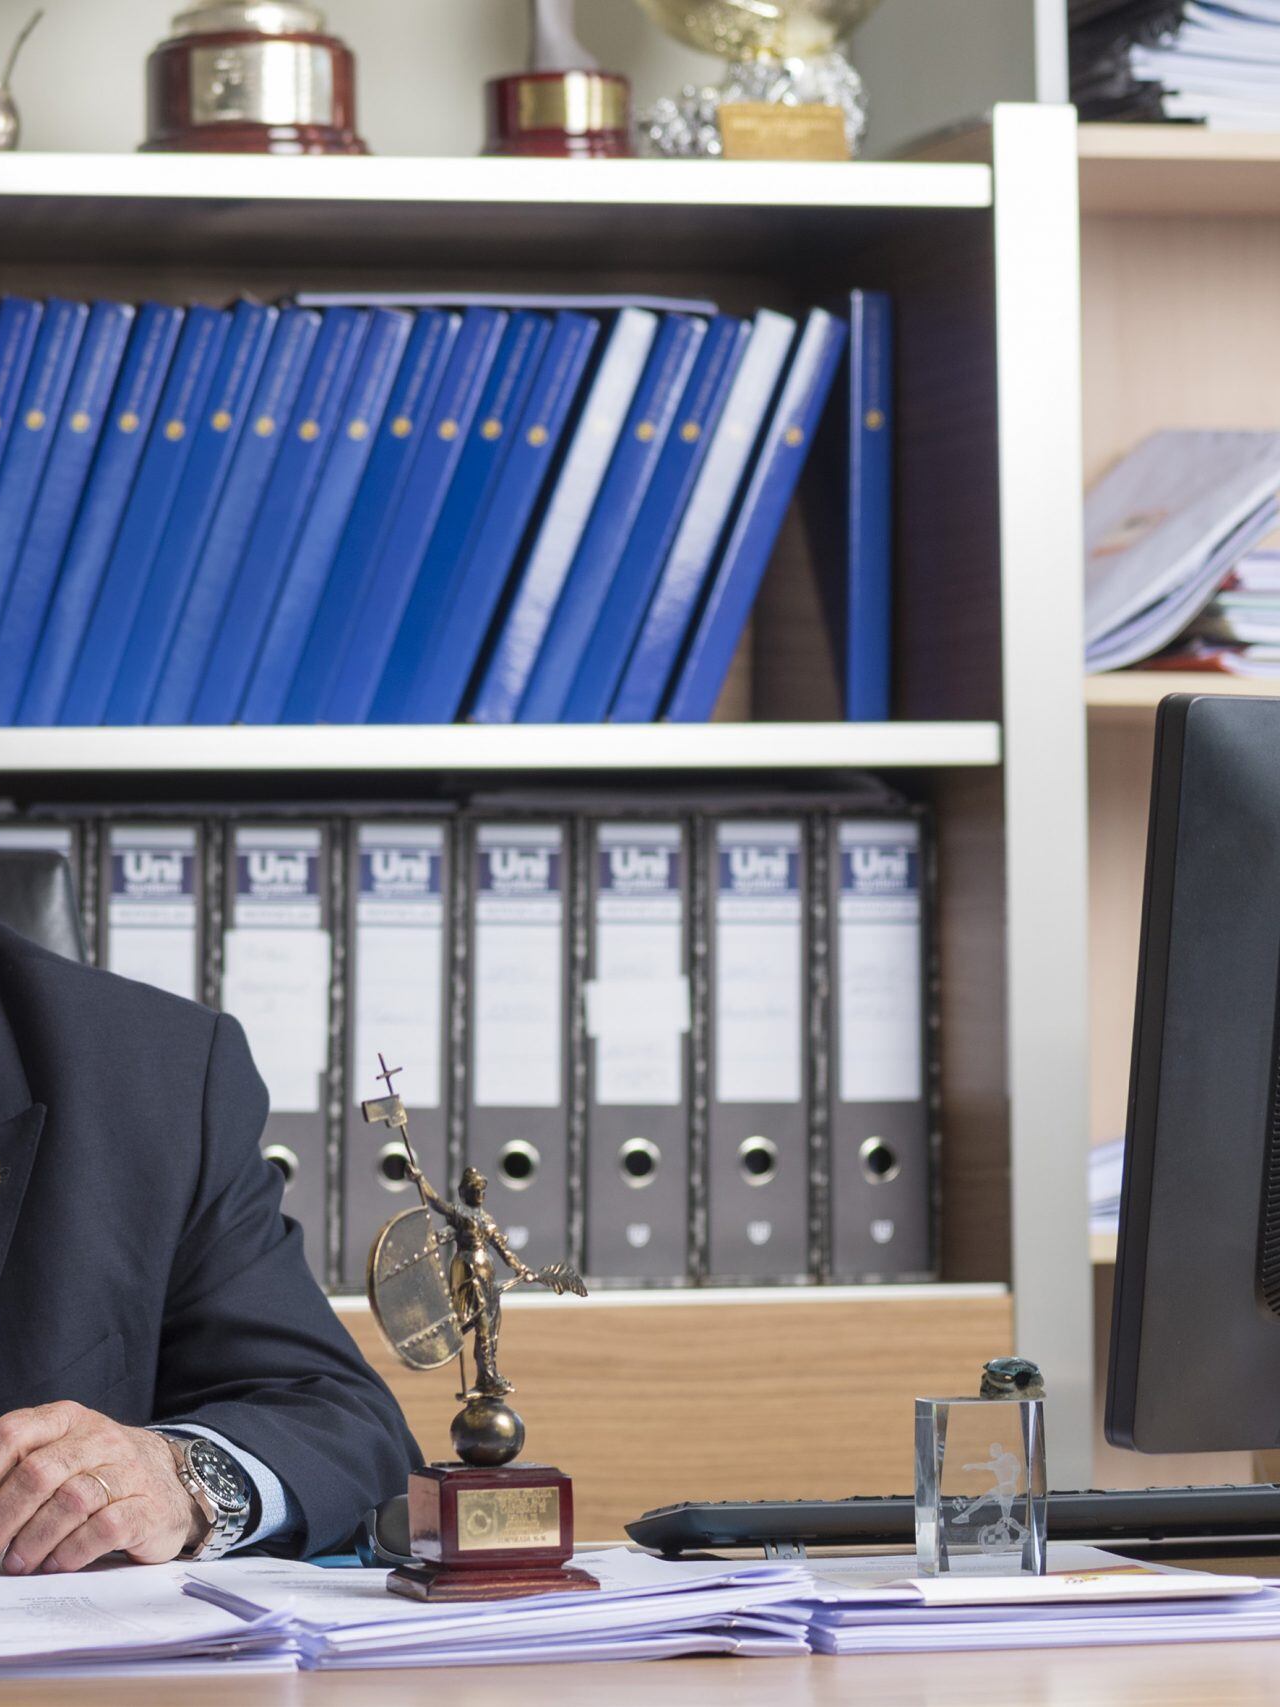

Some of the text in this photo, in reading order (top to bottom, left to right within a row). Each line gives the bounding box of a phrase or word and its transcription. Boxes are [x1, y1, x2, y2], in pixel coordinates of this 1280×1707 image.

[123, 850, 183, 883] Uni
[248, 850, 307, 884] Uni
[371, 850, 430, 883] Uni
[490, 848, 549, 881] Uni
[610, 846, 669, 879] Uni
[730, 846, 788, 880] Uni
[851, 846, 908, 879] Uni
